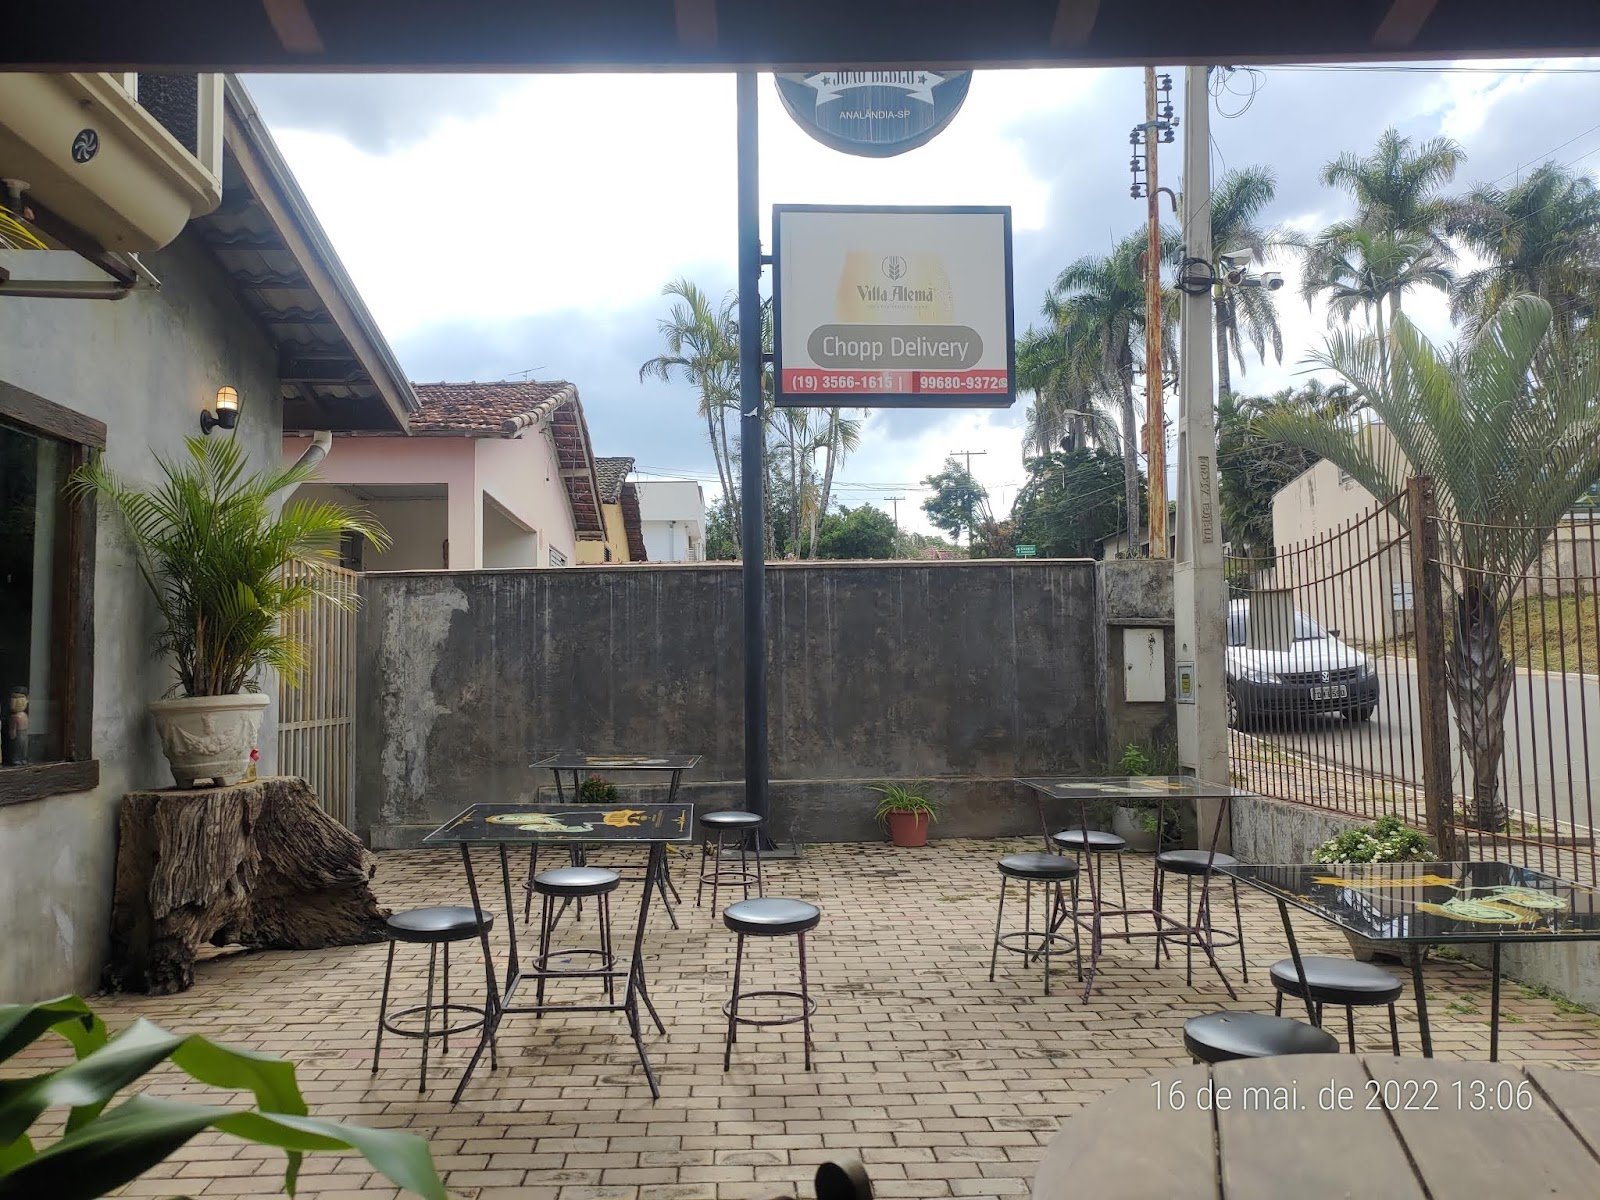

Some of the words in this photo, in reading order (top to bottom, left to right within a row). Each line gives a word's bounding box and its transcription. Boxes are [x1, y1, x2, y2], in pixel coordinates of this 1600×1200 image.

[857, 285, 888, 302] Villa
[890, 285, 934, 302] Alemã
[822, 336, 883, 362] Chopp
[890, 336, 970, 362] Delivery
[791, 375, 818, 391] (19)
[822, 376, 893, 390] 3566-1615
[920, 376, 999, 390] 99680-9372
